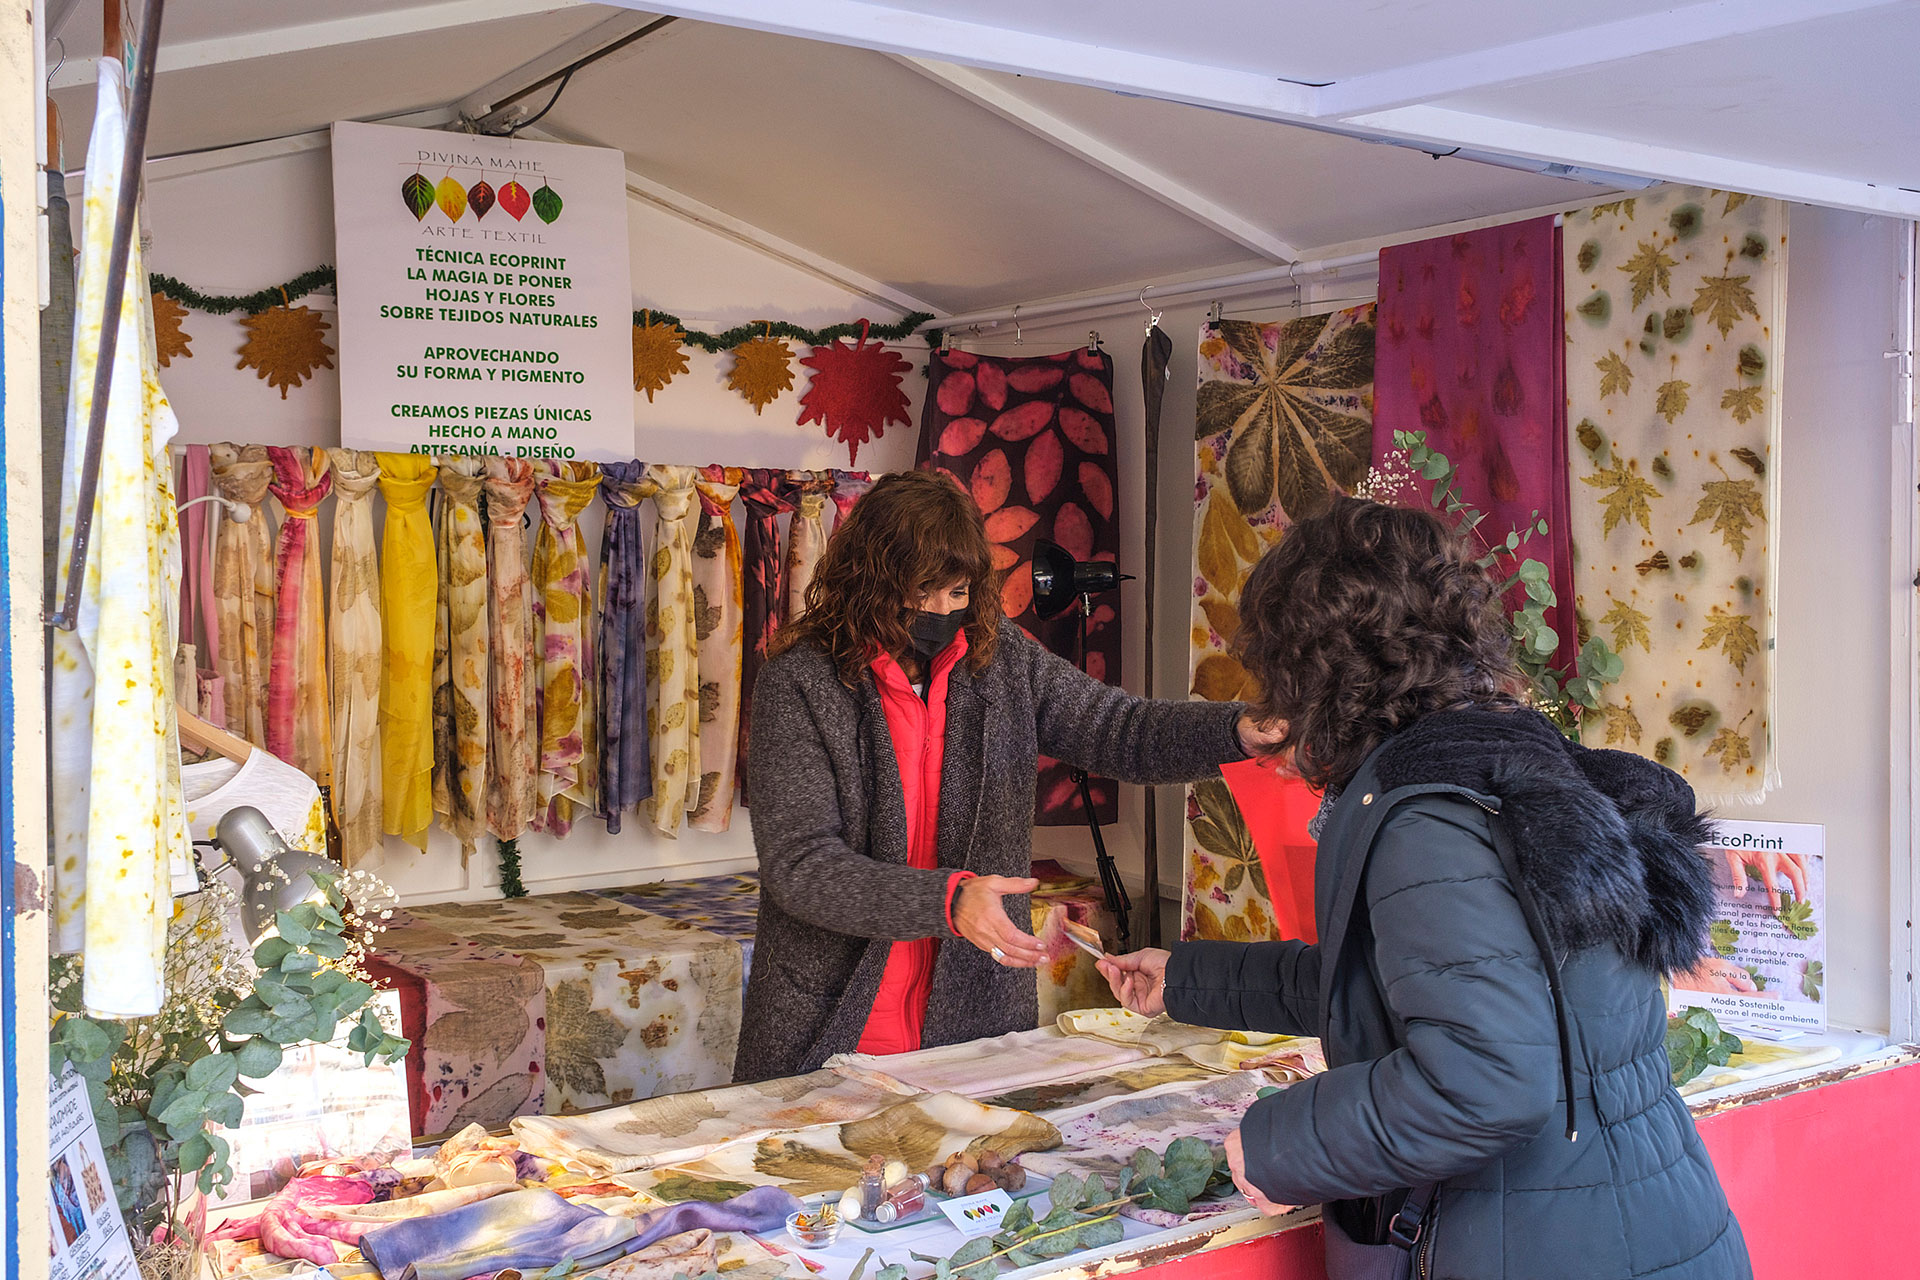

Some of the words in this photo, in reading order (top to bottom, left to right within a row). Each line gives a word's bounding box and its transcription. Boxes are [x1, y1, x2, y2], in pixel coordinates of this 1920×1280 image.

[418, 150, 484, 166] DIVINA
[490, 158, 545, 172] MAHE
[422, 225, 474, 239] ARTE
[480, 229, 546, 244] TEXTIL
[416, 245, 484, 265] TÉCNICA
[489, 253, 566, 270] ECOPRINT
[407, 267, 427, 281] LA
[432, 269, 488, 285] MAGIA
[493, 272, 513, 286] DE
[518, 274, 572, 289] PONER
[426, 288, 480, 303] HOJAS
[484, 291, 494, 304] Y
[499, 292, 556, 308] FLORES
[380, 305, 434, 320] SOBRE
[439, 308, 504, 324] TEJIDOS
[509, 312, 598, 328] NATURALES
[424, 346, 560, 364] APROVECHANDO
[396, 365, 418, 378] SU
[424, 366, 482, 381] FORMA
[486, 368, 496, 381] Y
[501, 369, 585, 384] PIGMENTO
[391, 404, 469, 419] CREAMOS
[474, 406, 529, 420] PIEZAS
[534, 404, 592, 422] ÚNICAS
[429, 425, 486, 439] HECHO
[491, 426, 502, 439] A
[507, 426, 557, 440] MANO
[409, 441, 499, 456] ARTESANÍA
[516, 442, 576, 459] DISEÑO
[1711, 831, 1784, 850] EcoPrint
[1745, 884, 1756, 892] de
[1757, 885, 1770, 893] las
[1741, 911, 1791, 921] permanente
[1755, 904, 1786, 912] manual
[1730, 927, 1741, 935] de
[1742, 928, 1769, 938] origen
[1734, 919, 1744, 927] de
[1746, 920, 1758, 928] las
[1760, 920, 1782, 930] hojas
[1791, 923, 1814, 933] flores
[1733, 947, 1749, 955] que
[1751, 946, 1778, 957] diseño
[1745, 955, 1789, 967] irrepetible.
[1739, 971, 1747, 980] la
[1711, 997, 1736, 1006] Moda
[1739, 999, 1785, 1012] Sostenible
[1724, 1008, 1739, 1016] con
[1741, 1009, 1749, 1017] el
[1751, 1011, 1778, 1020] medio
[1779, 1013, 1819, 1025] ambiente
